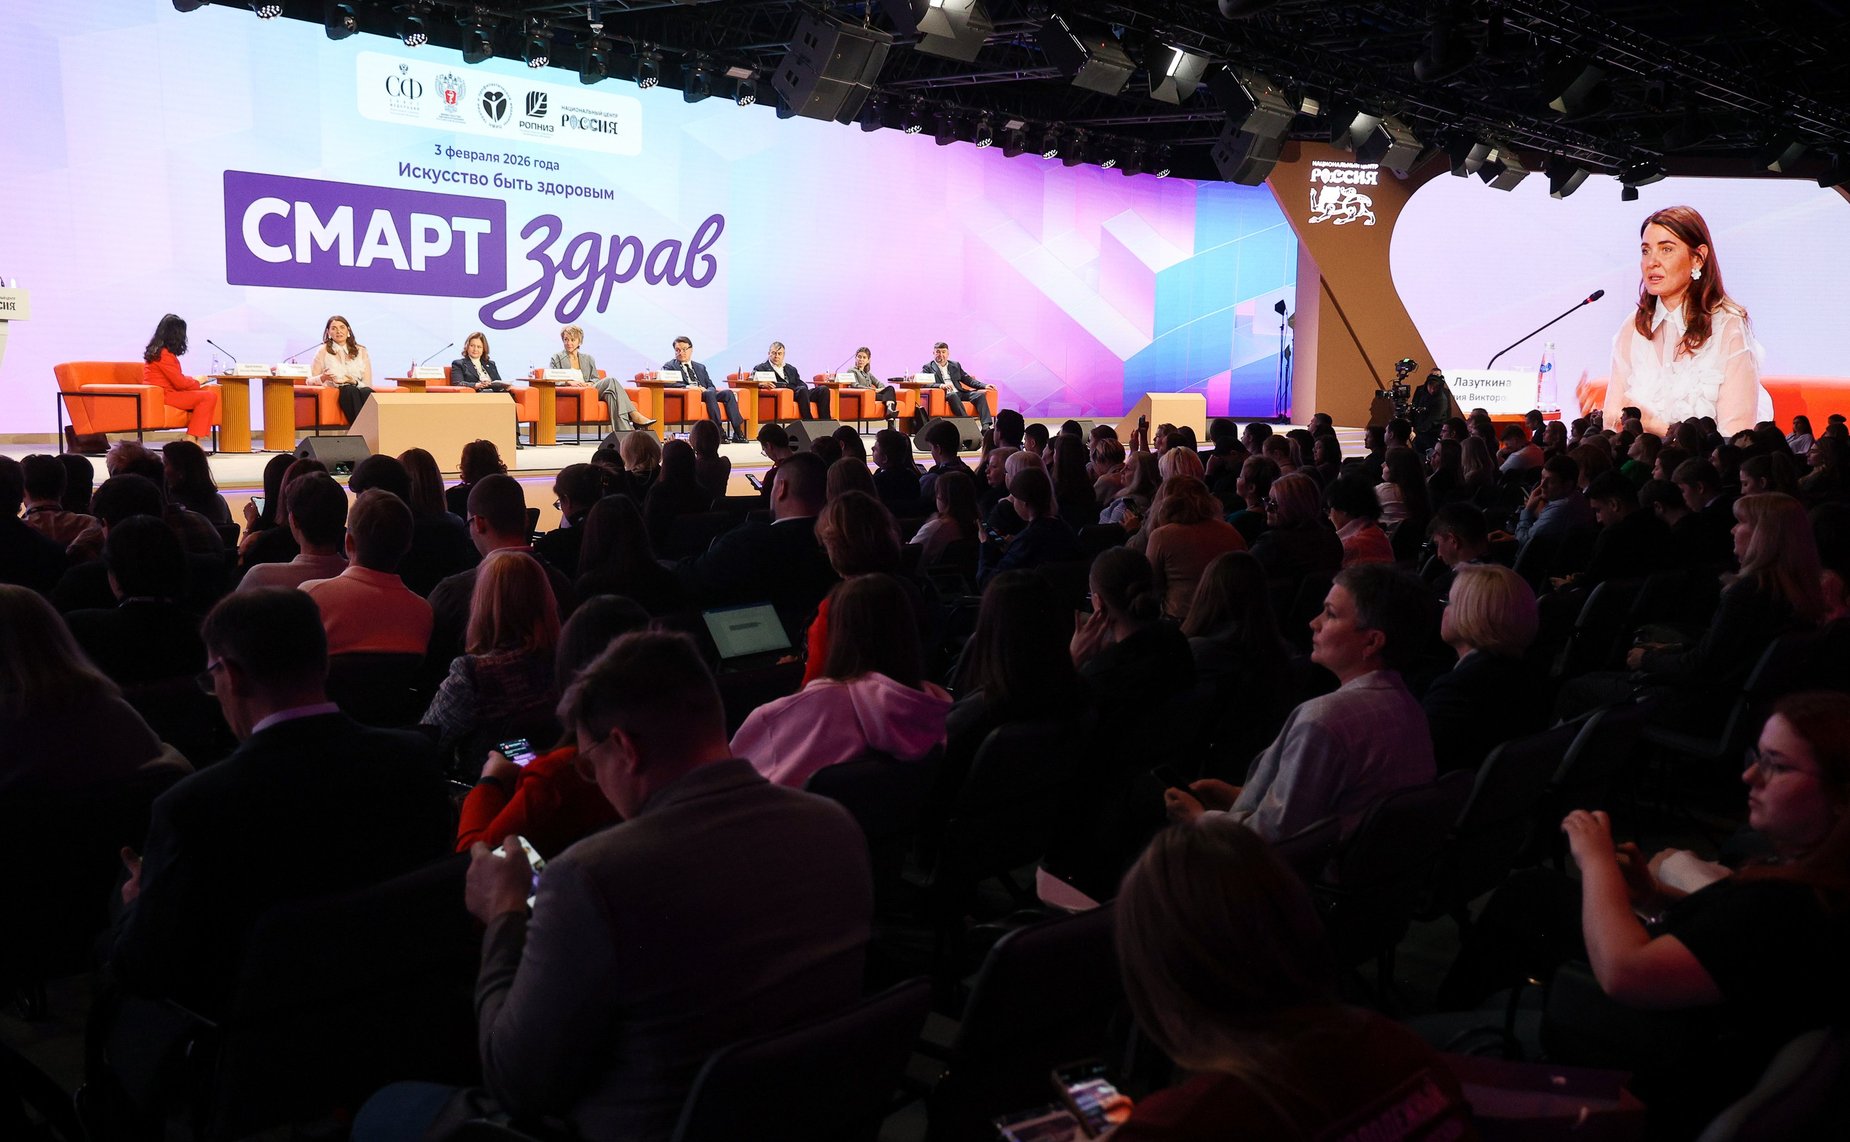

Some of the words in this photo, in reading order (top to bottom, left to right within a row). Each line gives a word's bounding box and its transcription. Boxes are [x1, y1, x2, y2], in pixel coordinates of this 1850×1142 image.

[385, 75, 423, 100] СФ
[519, 120, 555, 133] РОПНИЗ
[561, 114, 618, 135] РОССИЯ
[434, 144, 442, 155] 3
[445, 146, 500, 162] февраля
[503, 153, 531, 167] 2026
[534, 159, 560, 171] года
[399, 161, 489, 185] Искусство
[493, 173, 533, 192] быть
[537, 181, 615, 200] здоровым
[1310, 168, 1379, 185] РОССИЯ
[242, 196, 492, 275] СМАРТ
[478, 213, 725, 330] Здрав
[1453, 377, 1512, 388] Лазуткина
